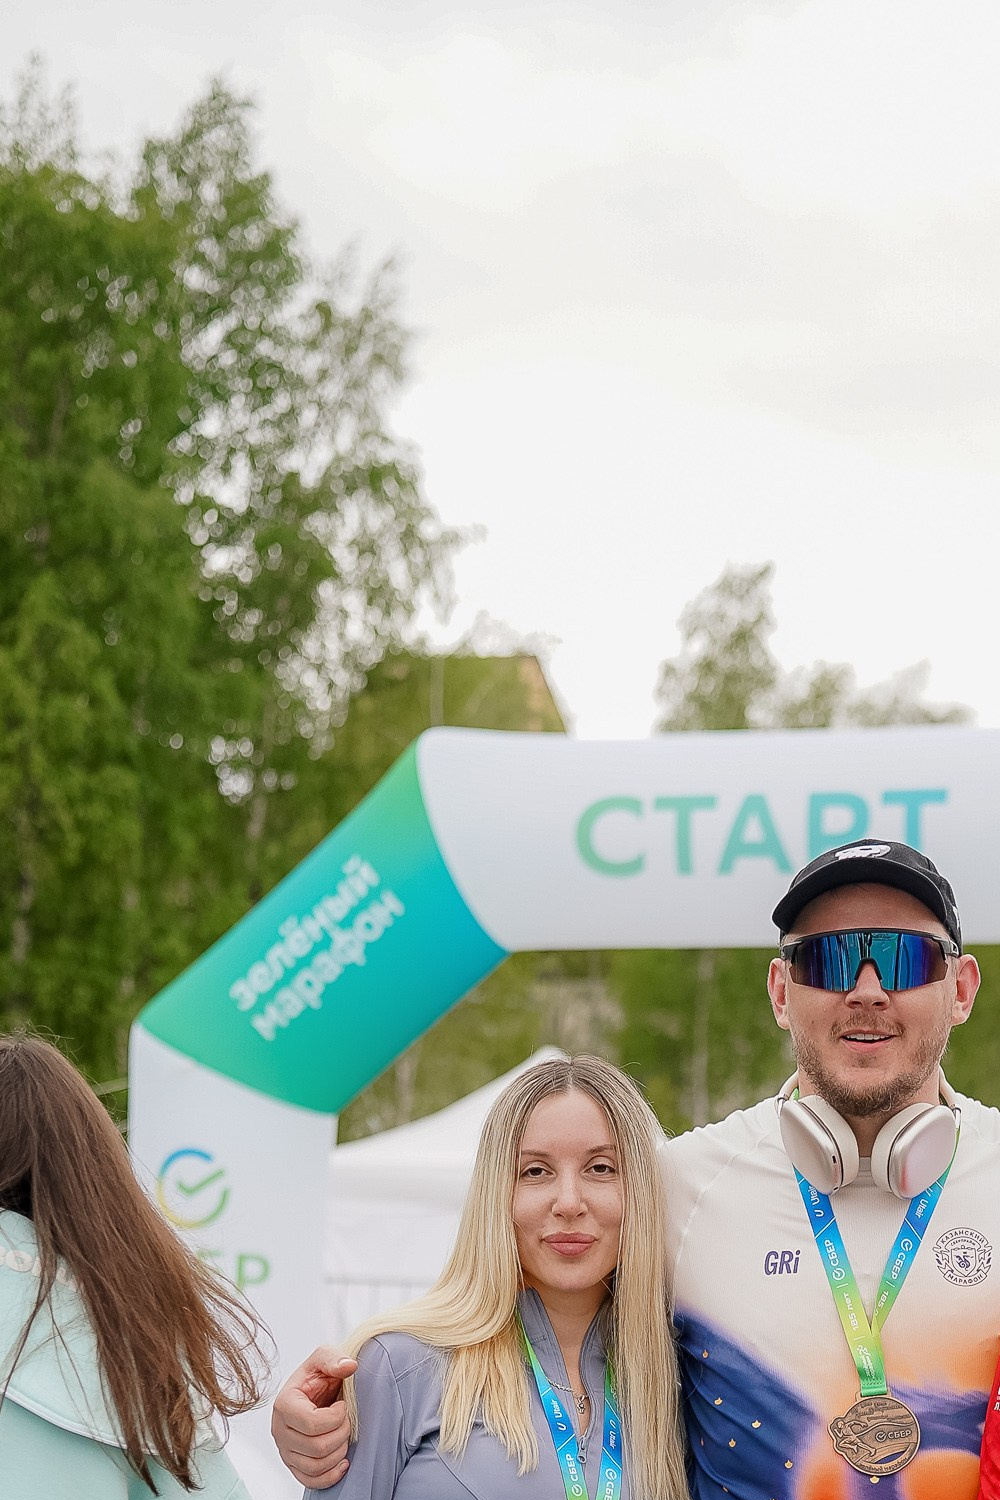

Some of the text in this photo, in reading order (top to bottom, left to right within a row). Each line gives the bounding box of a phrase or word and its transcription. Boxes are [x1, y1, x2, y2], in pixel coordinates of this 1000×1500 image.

[575, 788, 948, 877] СТАРТ
[229, 854, 380, 1011] зелёный
[250, 888, 405, 1041] марафон
[764, 1249, 801, 1276] GRi
[824, 1239, 839, 1267] СБЕР
[891, 1252, 906, 1280] СБЕР
[947, 1273, 984, 1285] МАРАФОН
[888, 1429, 912, 1439] СБЕР
[566, 1453, 579, 1482] СБЕР
